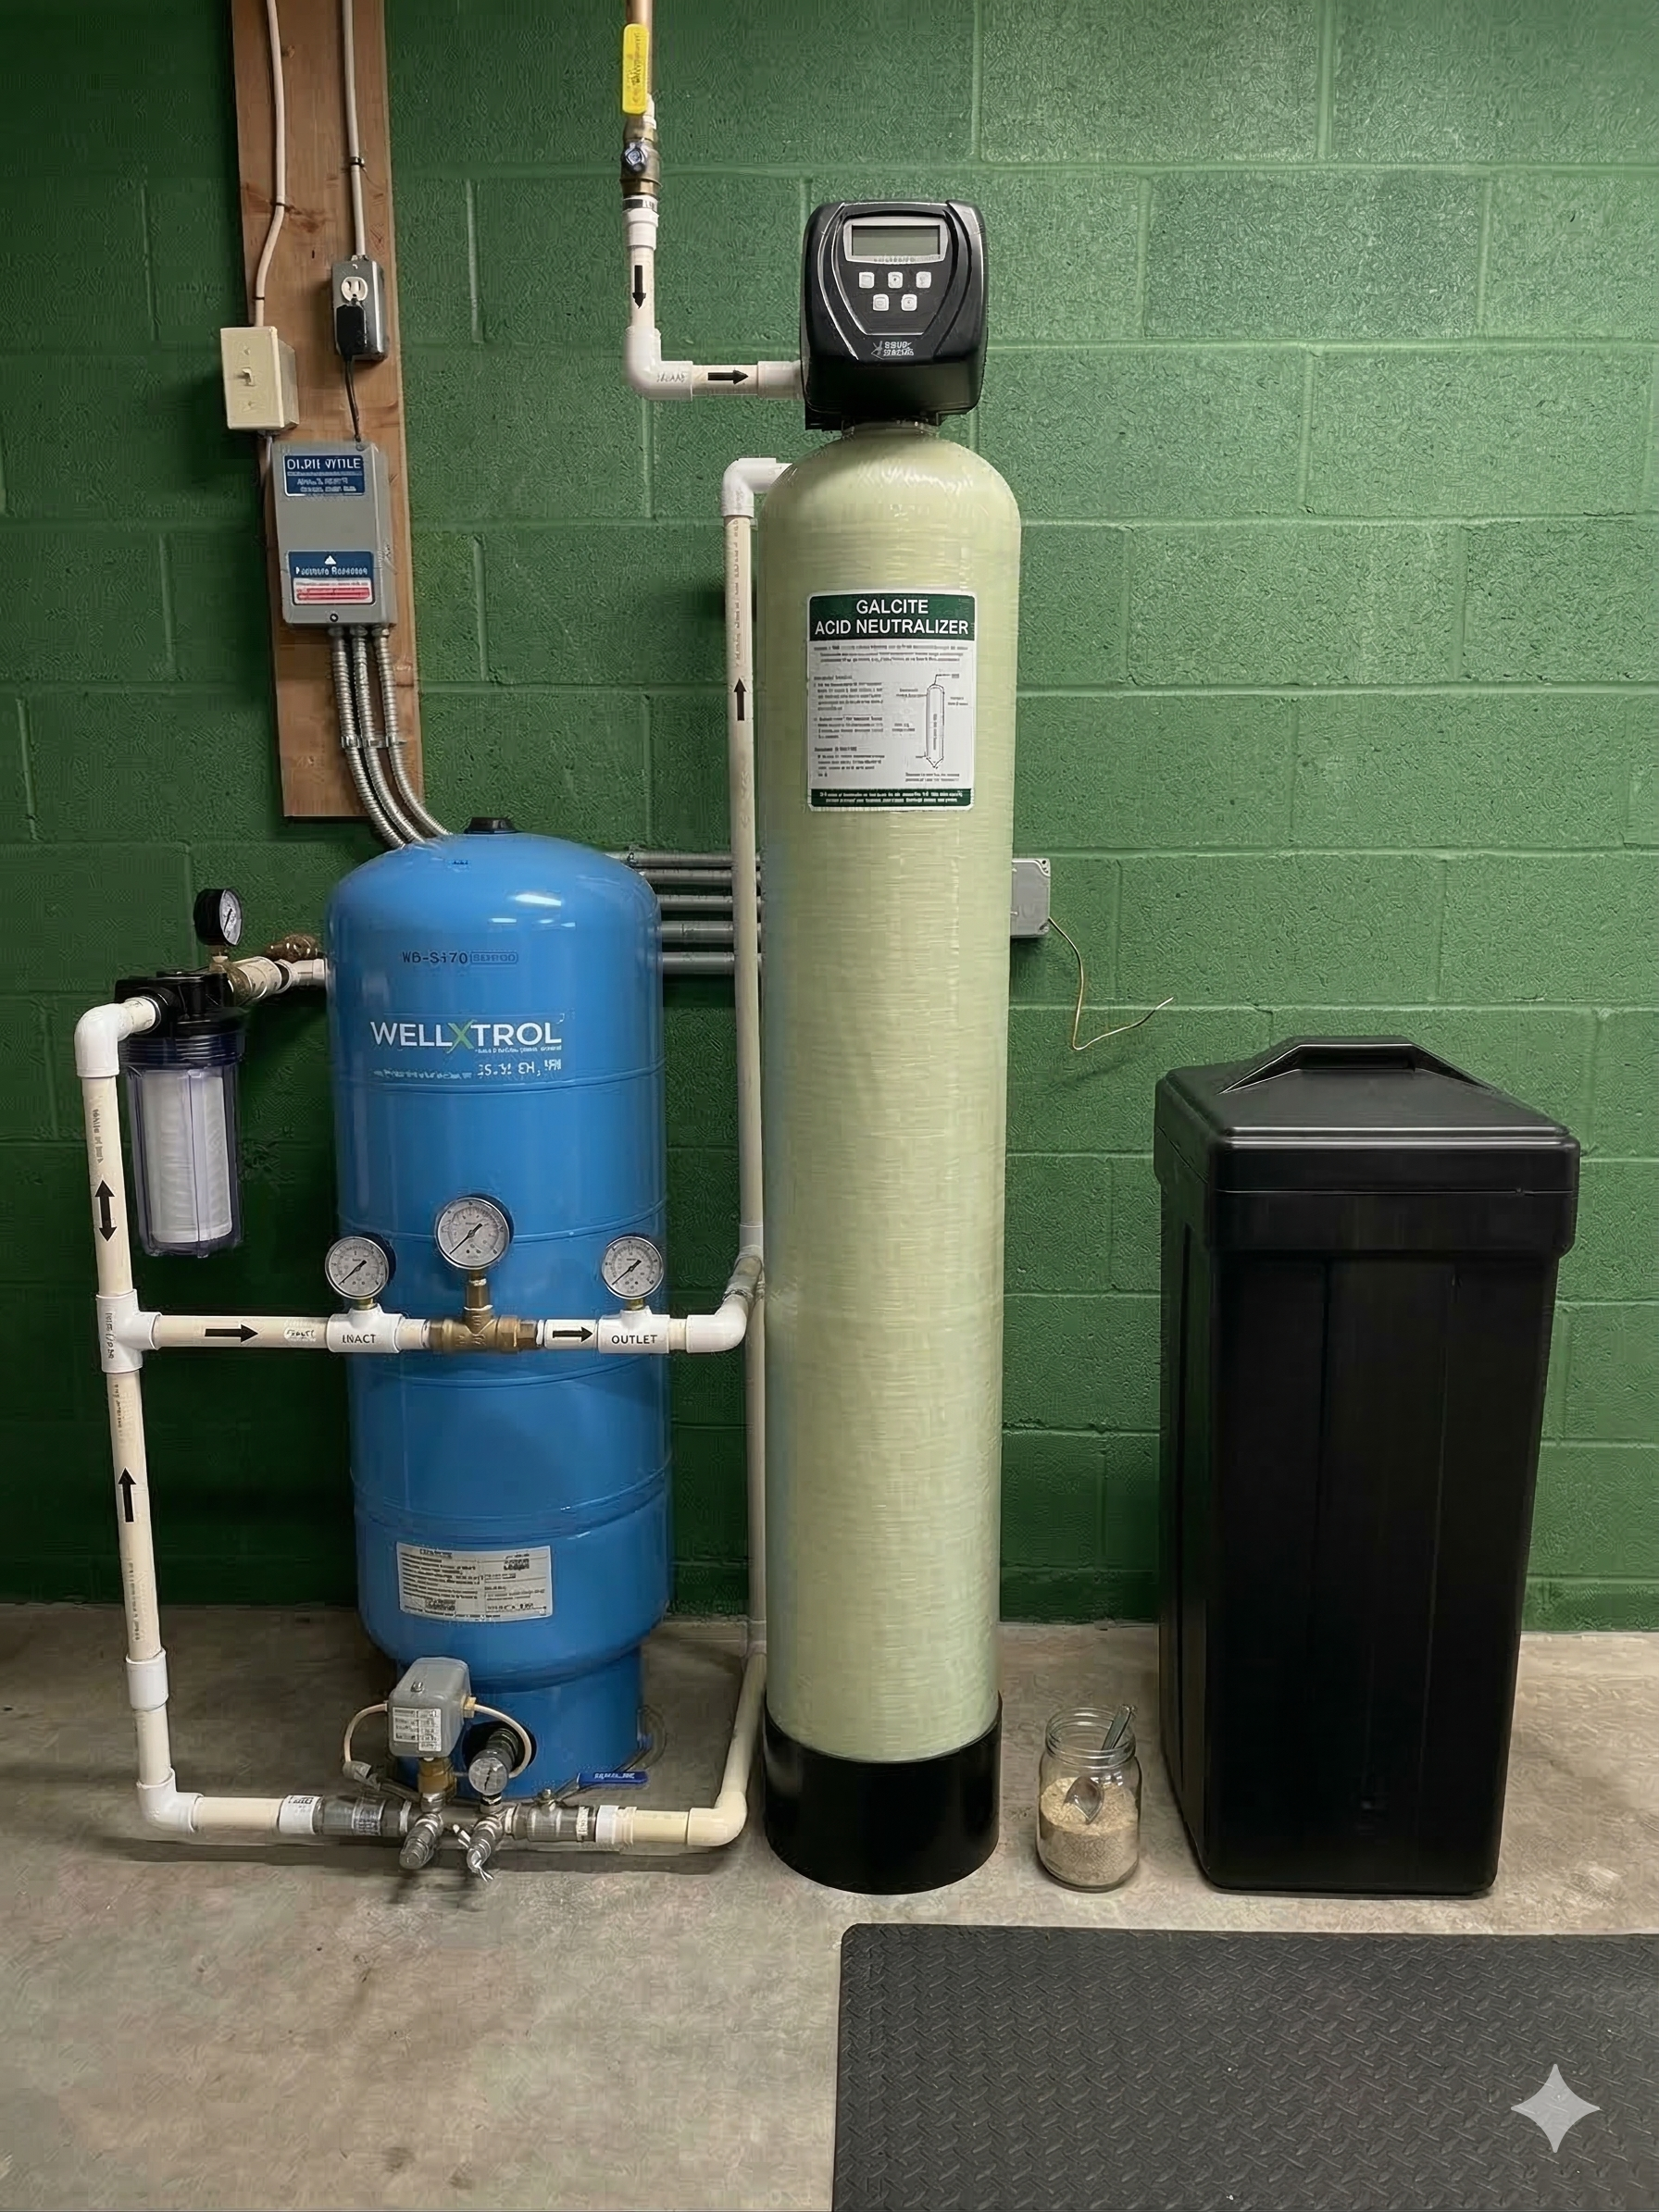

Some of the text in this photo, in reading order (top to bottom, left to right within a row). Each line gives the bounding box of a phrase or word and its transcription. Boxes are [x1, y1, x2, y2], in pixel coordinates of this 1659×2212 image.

[855, 599, 929, 615] GALCITE
[815, 619, 969, 635] ACID NEUTRALIZER
[370, 1019, 563, 1052] WELLXTROL
[611, 1335, 657, 1344] OUTLET
